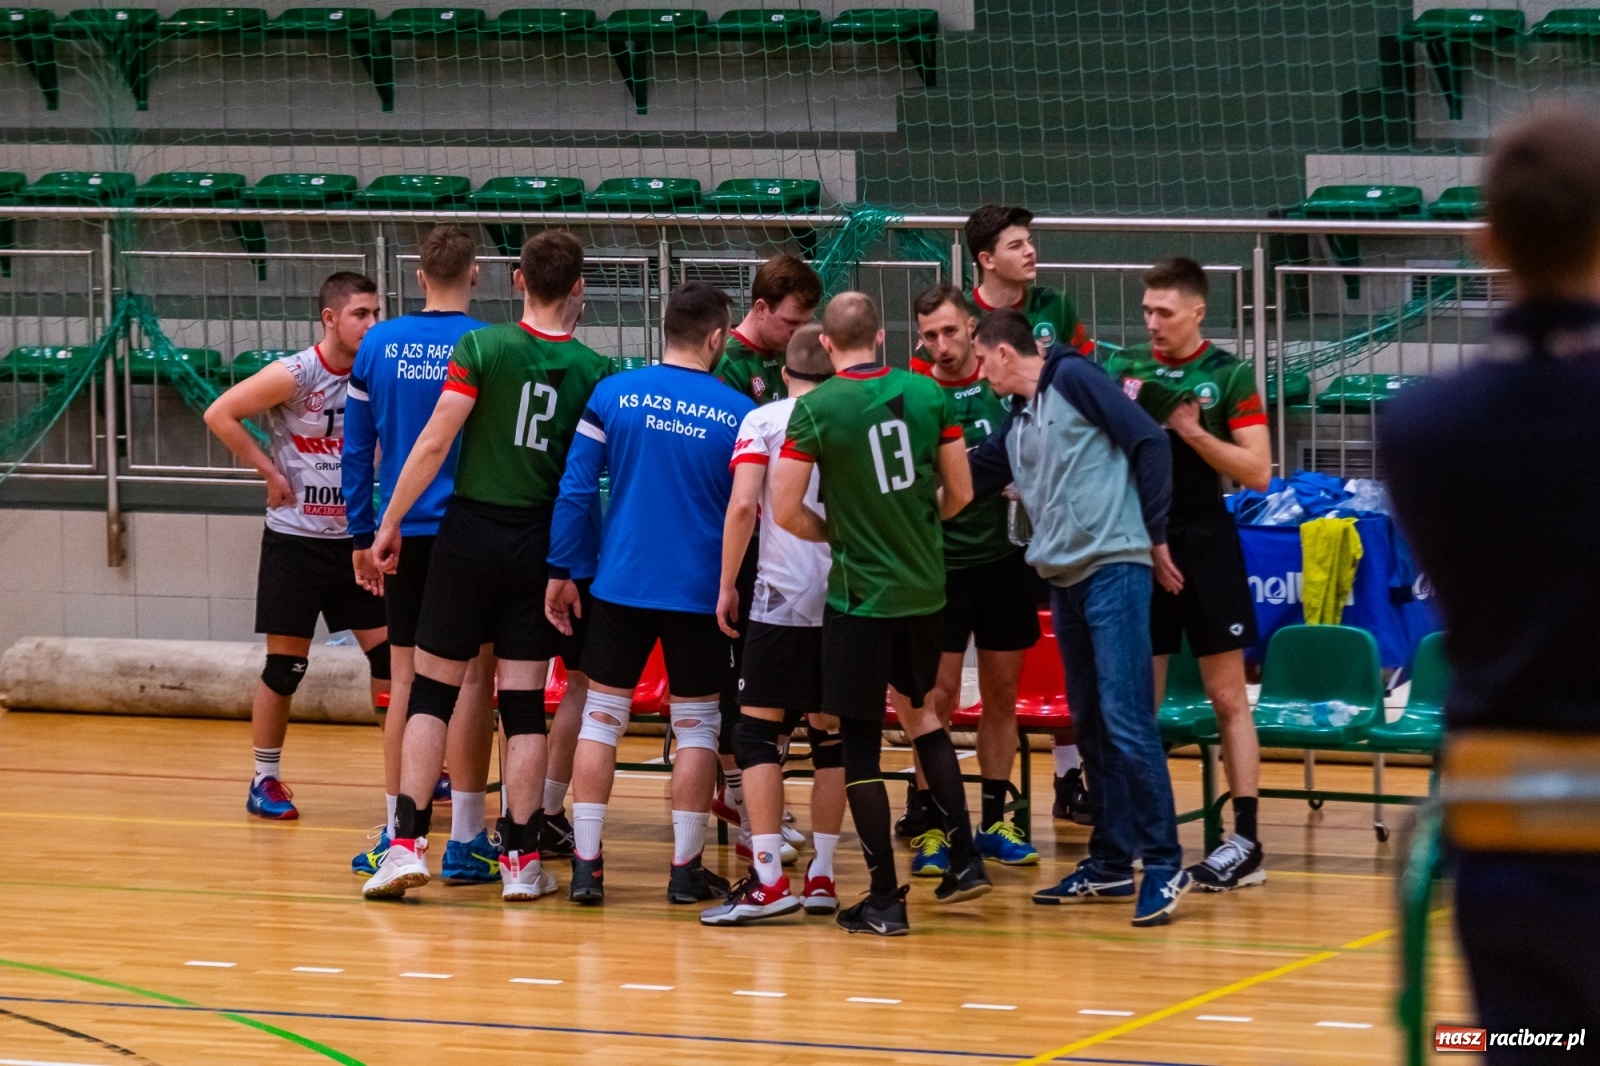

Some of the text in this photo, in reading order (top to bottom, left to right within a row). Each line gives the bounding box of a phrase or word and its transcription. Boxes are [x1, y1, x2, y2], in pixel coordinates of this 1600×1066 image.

[385, 343, 454, 360] KS AZS RAFA
[397, 360, 449, 380] Racibór
[513, 380, 558, 452] 12
[619, 393, 739, 429] KS AZS RAFAKO
[645, 414, 707, 440] Racibórz
[314, 462, 342, 471] GRUP
[867, 418, 916, 495] 13
[304, 505, 346, 516] RACIBOR
